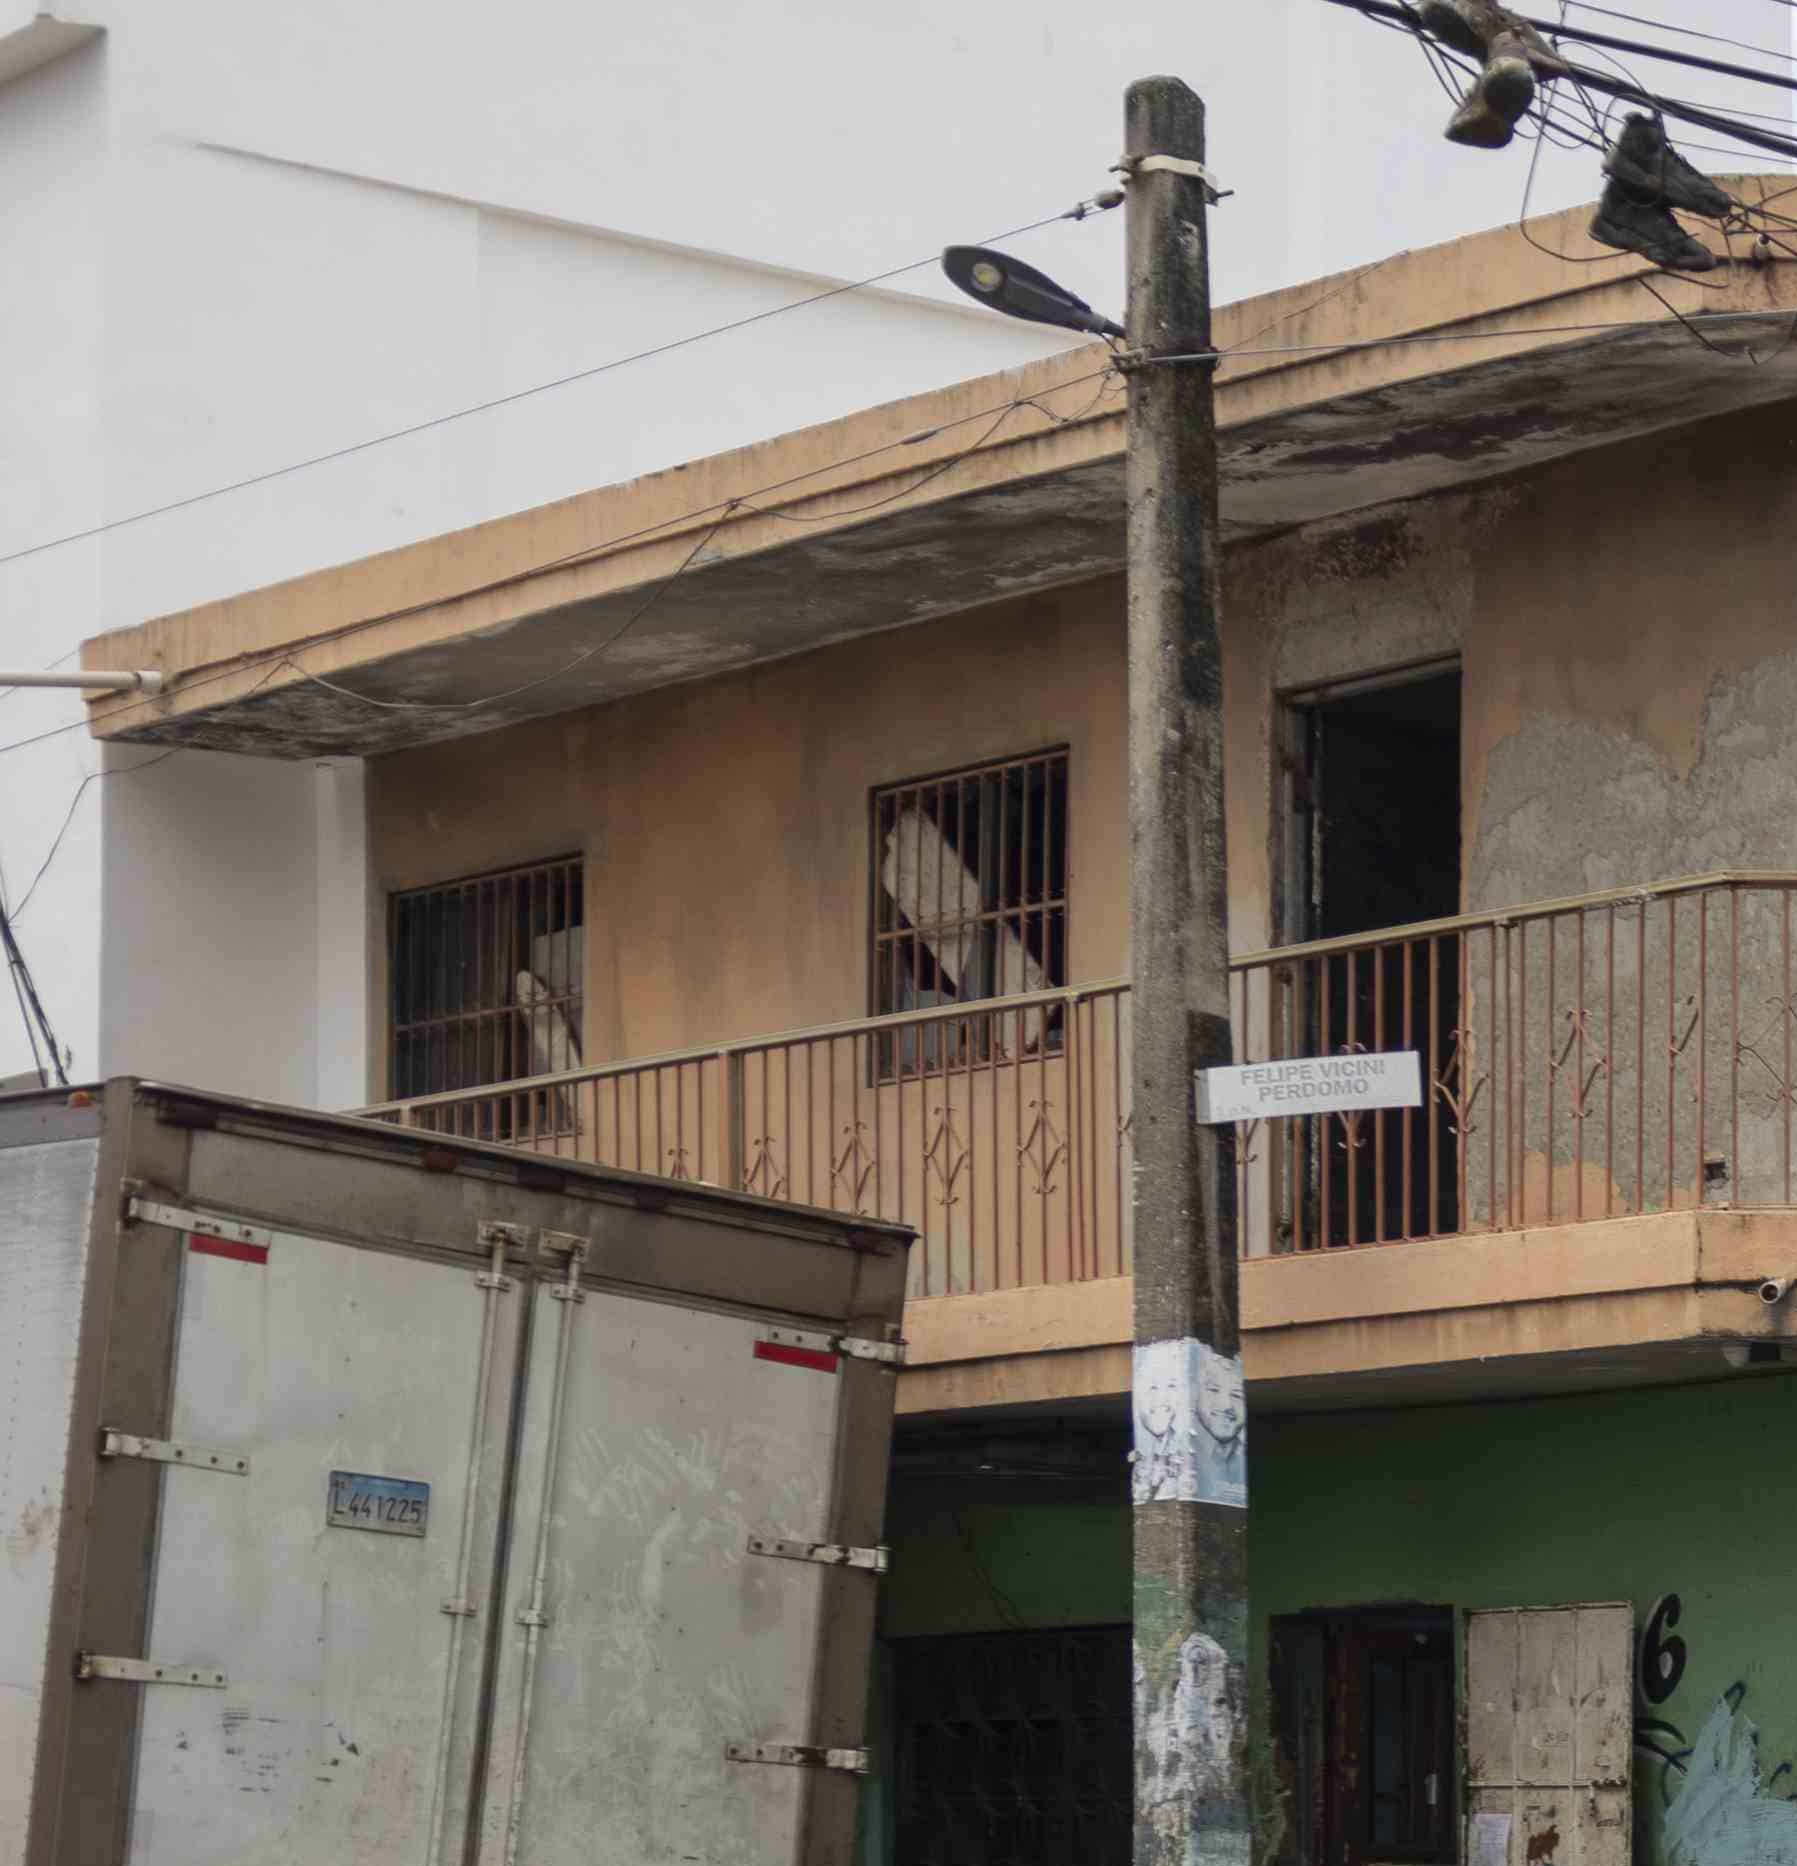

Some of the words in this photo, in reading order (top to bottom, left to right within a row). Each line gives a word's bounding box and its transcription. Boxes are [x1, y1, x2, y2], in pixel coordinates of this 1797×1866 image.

[1241, 1065, 1312, 1086] FELIPE
[1319, 1059, 1385, 1079] VICINI
[1259, 1079, 1369, 1102] PERDOMO
